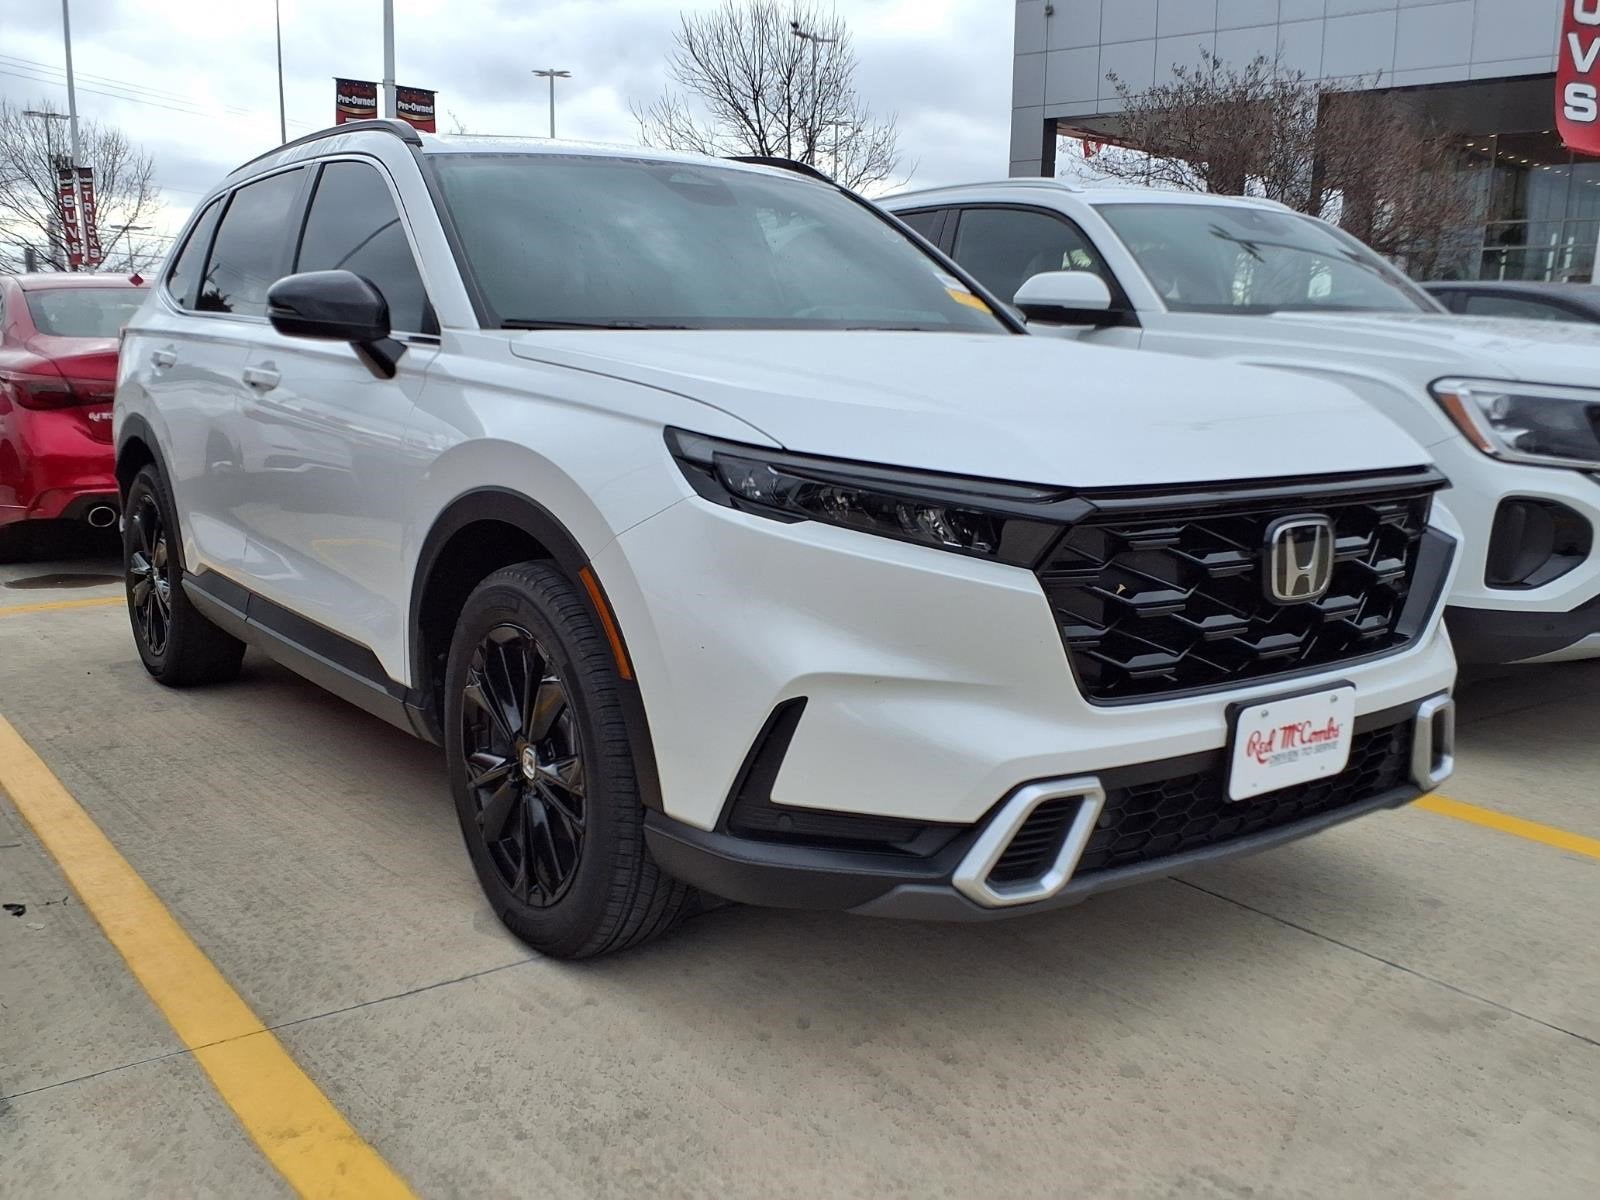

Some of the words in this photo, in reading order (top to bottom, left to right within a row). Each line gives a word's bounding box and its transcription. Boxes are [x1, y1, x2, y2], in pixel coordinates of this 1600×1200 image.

[337, 94, 376, 107] Pre-Owned
[397, 101, 434, 114] Pre-Owned
[82, 191, 100, 258] TRUCKS
[1247, 728, 1276, 764] Red
